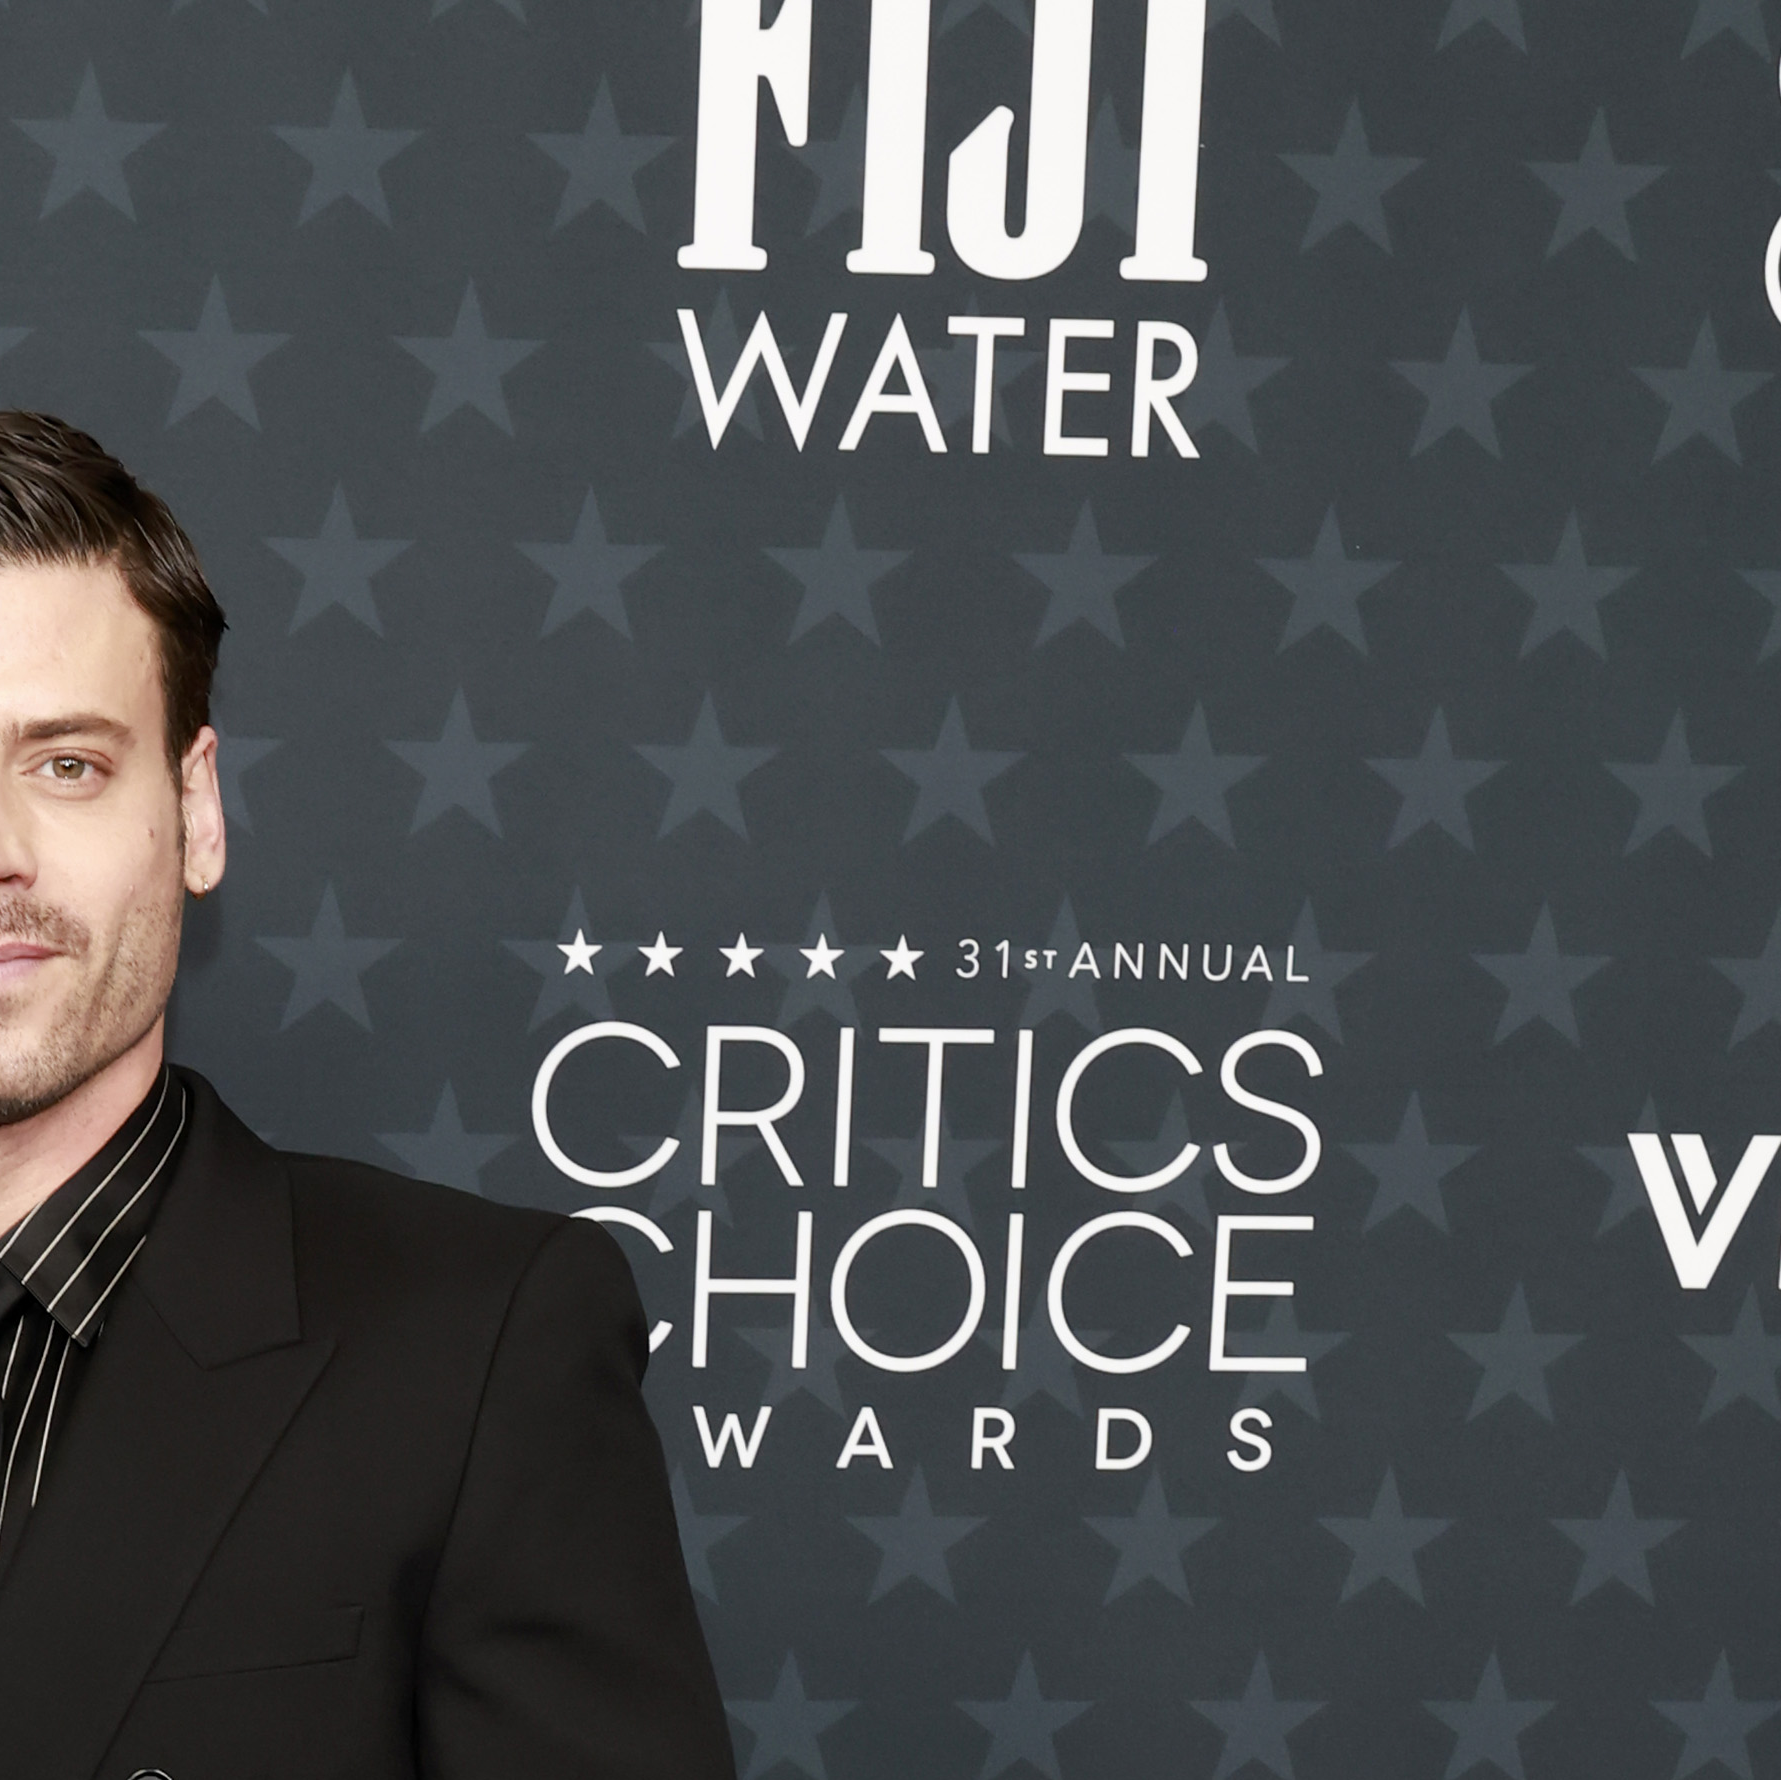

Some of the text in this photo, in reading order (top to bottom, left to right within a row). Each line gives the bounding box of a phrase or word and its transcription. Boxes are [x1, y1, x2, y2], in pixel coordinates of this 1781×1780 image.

[677, 0, 1207, 281] FIJI
[676, 308, 1200, 459] WATER
[1068, 942, 1310, 982] ANNUAL
[531, 1021, 1323, 1194] CRITICS
[692, 1405, 1273, 1472] WARDS
